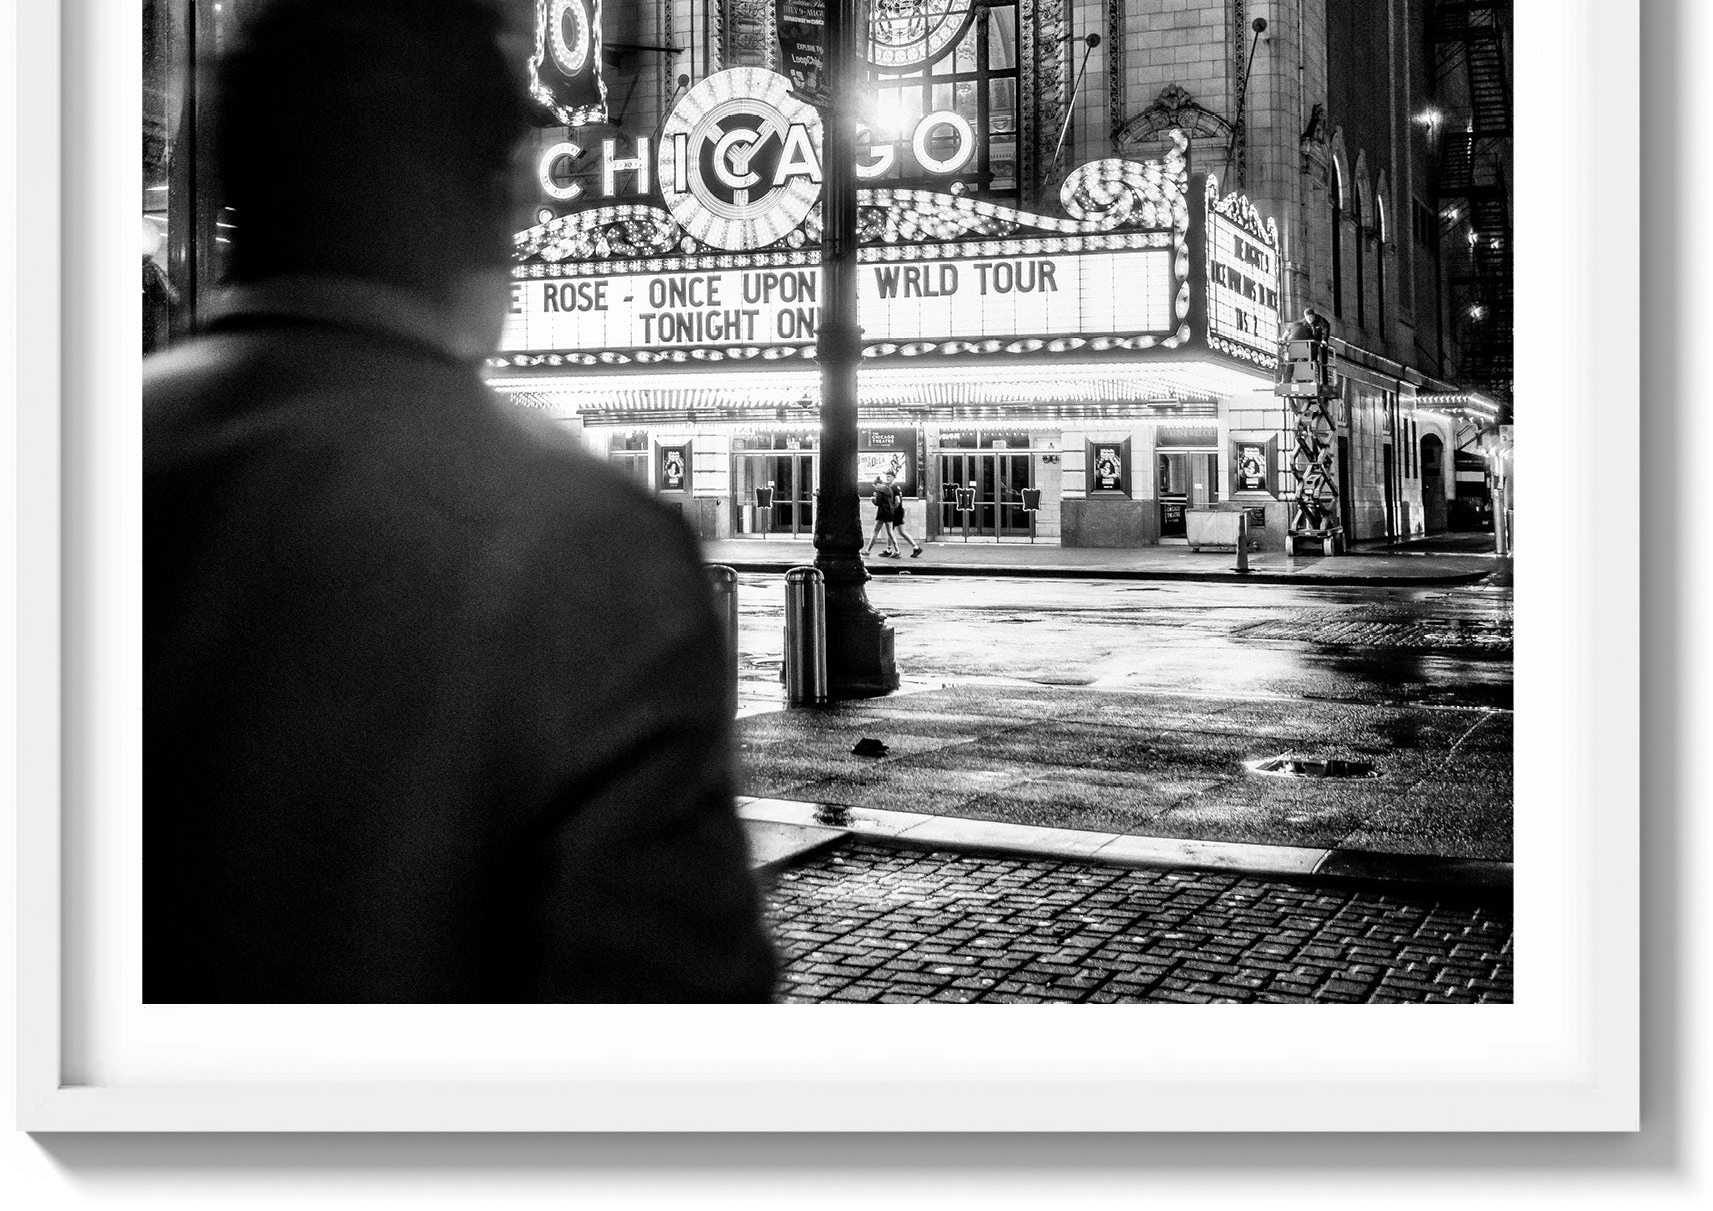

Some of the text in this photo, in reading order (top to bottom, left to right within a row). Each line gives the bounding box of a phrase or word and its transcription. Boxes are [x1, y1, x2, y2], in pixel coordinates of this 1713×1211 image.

[539, 110, 975, 200] CHICAGO
[543, 280, 609, 313] ROSE
[649, 275, 722, 309] ONCE
[743, 271, 816, 304] UPON
[873, 263, 959, 300] WRLD
[973, 260, 1059, 296] TOUR
[639, 308, 760, 344] TONIGHT
